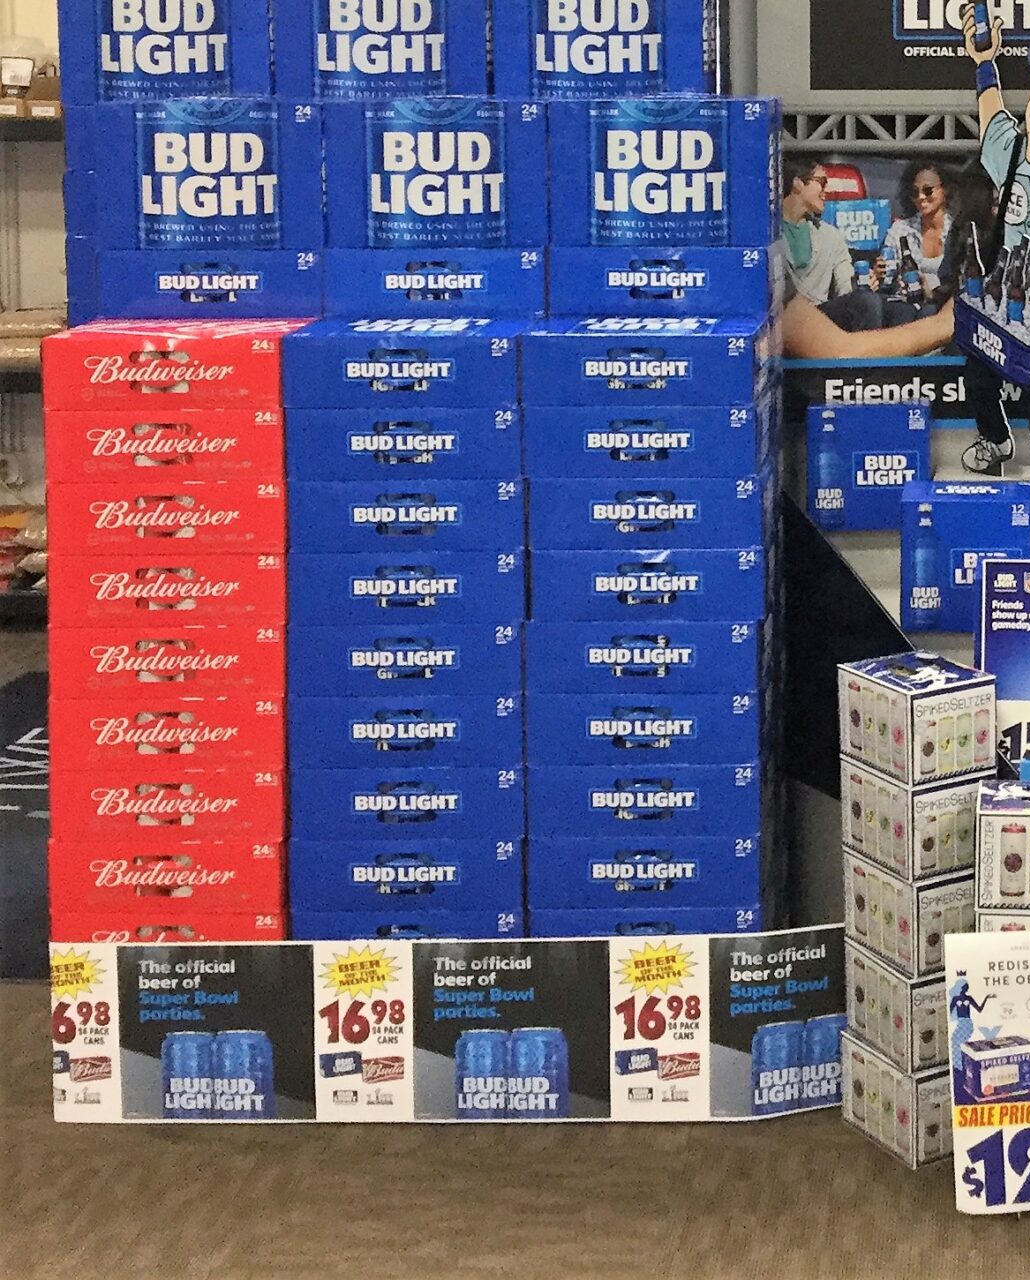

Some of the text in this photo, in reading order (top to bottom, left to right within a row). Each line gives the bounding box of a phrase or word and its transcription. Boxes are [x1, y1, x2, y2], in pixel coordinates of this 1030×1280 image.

[101, 34, 227, 74] LIGHT
[317, 34, 444, 74] LIGHT
[536, 34, 661, 74] LIGHT
[904, 47, 955, 56] OFFICIAL
[154, 133, 263, 173] BUD
[383, 132, 490, 172] BUD
[607, 130, 713, 170] BUD
[142, 175, 277, 217] LIGHT
[371, 173, 503, 215] LIGHT
[595, 172, 726, 213] LIGHT
[159, 274, 258, 290] BUD LIGHT
[972, 333, 1007, 366] LIGHT
[977, 324, 1003, 349] BUD
[84, 355, 233, 384] Budweiser
[585, 361, 688, 376] BUD LIGHT
[826, 377, 935, 407] Friends
[87, 428, 237, 456] Budweiser
[865, 455, 908, 469] BUD
[856, 469, 916, 486] LIGHT
[89, 501, 239, 528] Budweiser
[90, 573, 239, 600] Budweiser
[992, 600, 1024, 609] Friends
[992, 611, 1014, 620] show
[1015, 613, 1027, 622] up
[139, 960, 236, 974] The official
[138, 976, 201, 989] beer of
[984, 976, 1010, 986] THE
[959, 1105, 994, 1127] SALE
